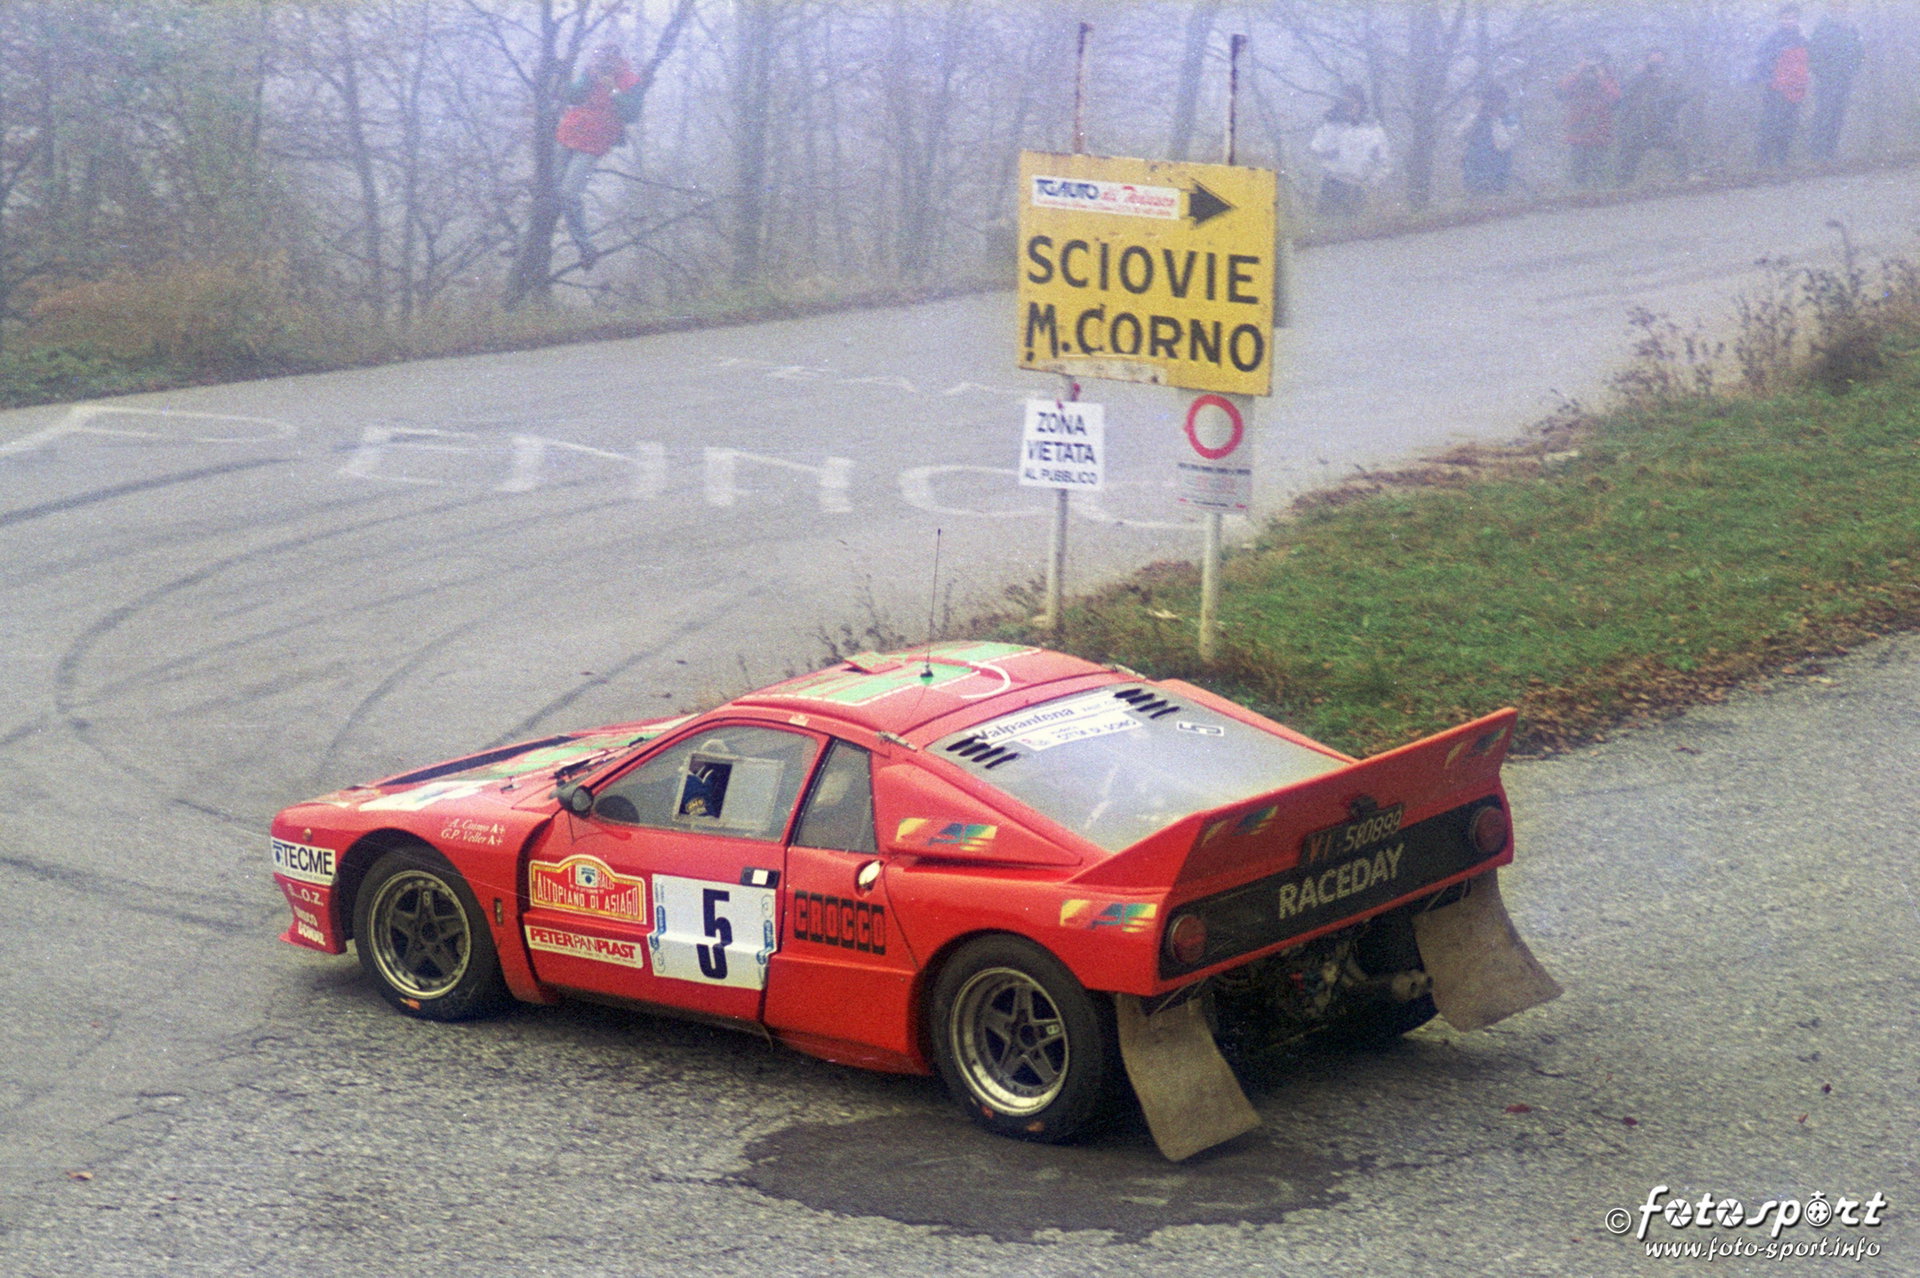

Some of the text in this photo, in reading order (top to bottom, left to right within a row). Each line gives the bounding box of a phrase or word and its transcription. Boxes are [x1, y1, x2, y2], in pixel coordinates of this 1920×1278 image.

[1027, 235, 1260, 304] SCIOVIE
[1026, 302, 1264, 372] M.CORNO
[1036, 410, 1087, 436] ZONA
[1027, 440, 1096, 465] VIETATA
[1041, 470, 1097, 485] PUBBLICO
[282, 843, 333, 876] TECME
[1279, 843, 1404, 920] RACEDAY
[537, 872, 585, 907] ALTOPIANO
[590, 894, 599, 909] DI
[604, 886, 638, 917] ASIAGO
[696, 888, 733, 980] 5
[794, 890, 886, 955] CROCCO
